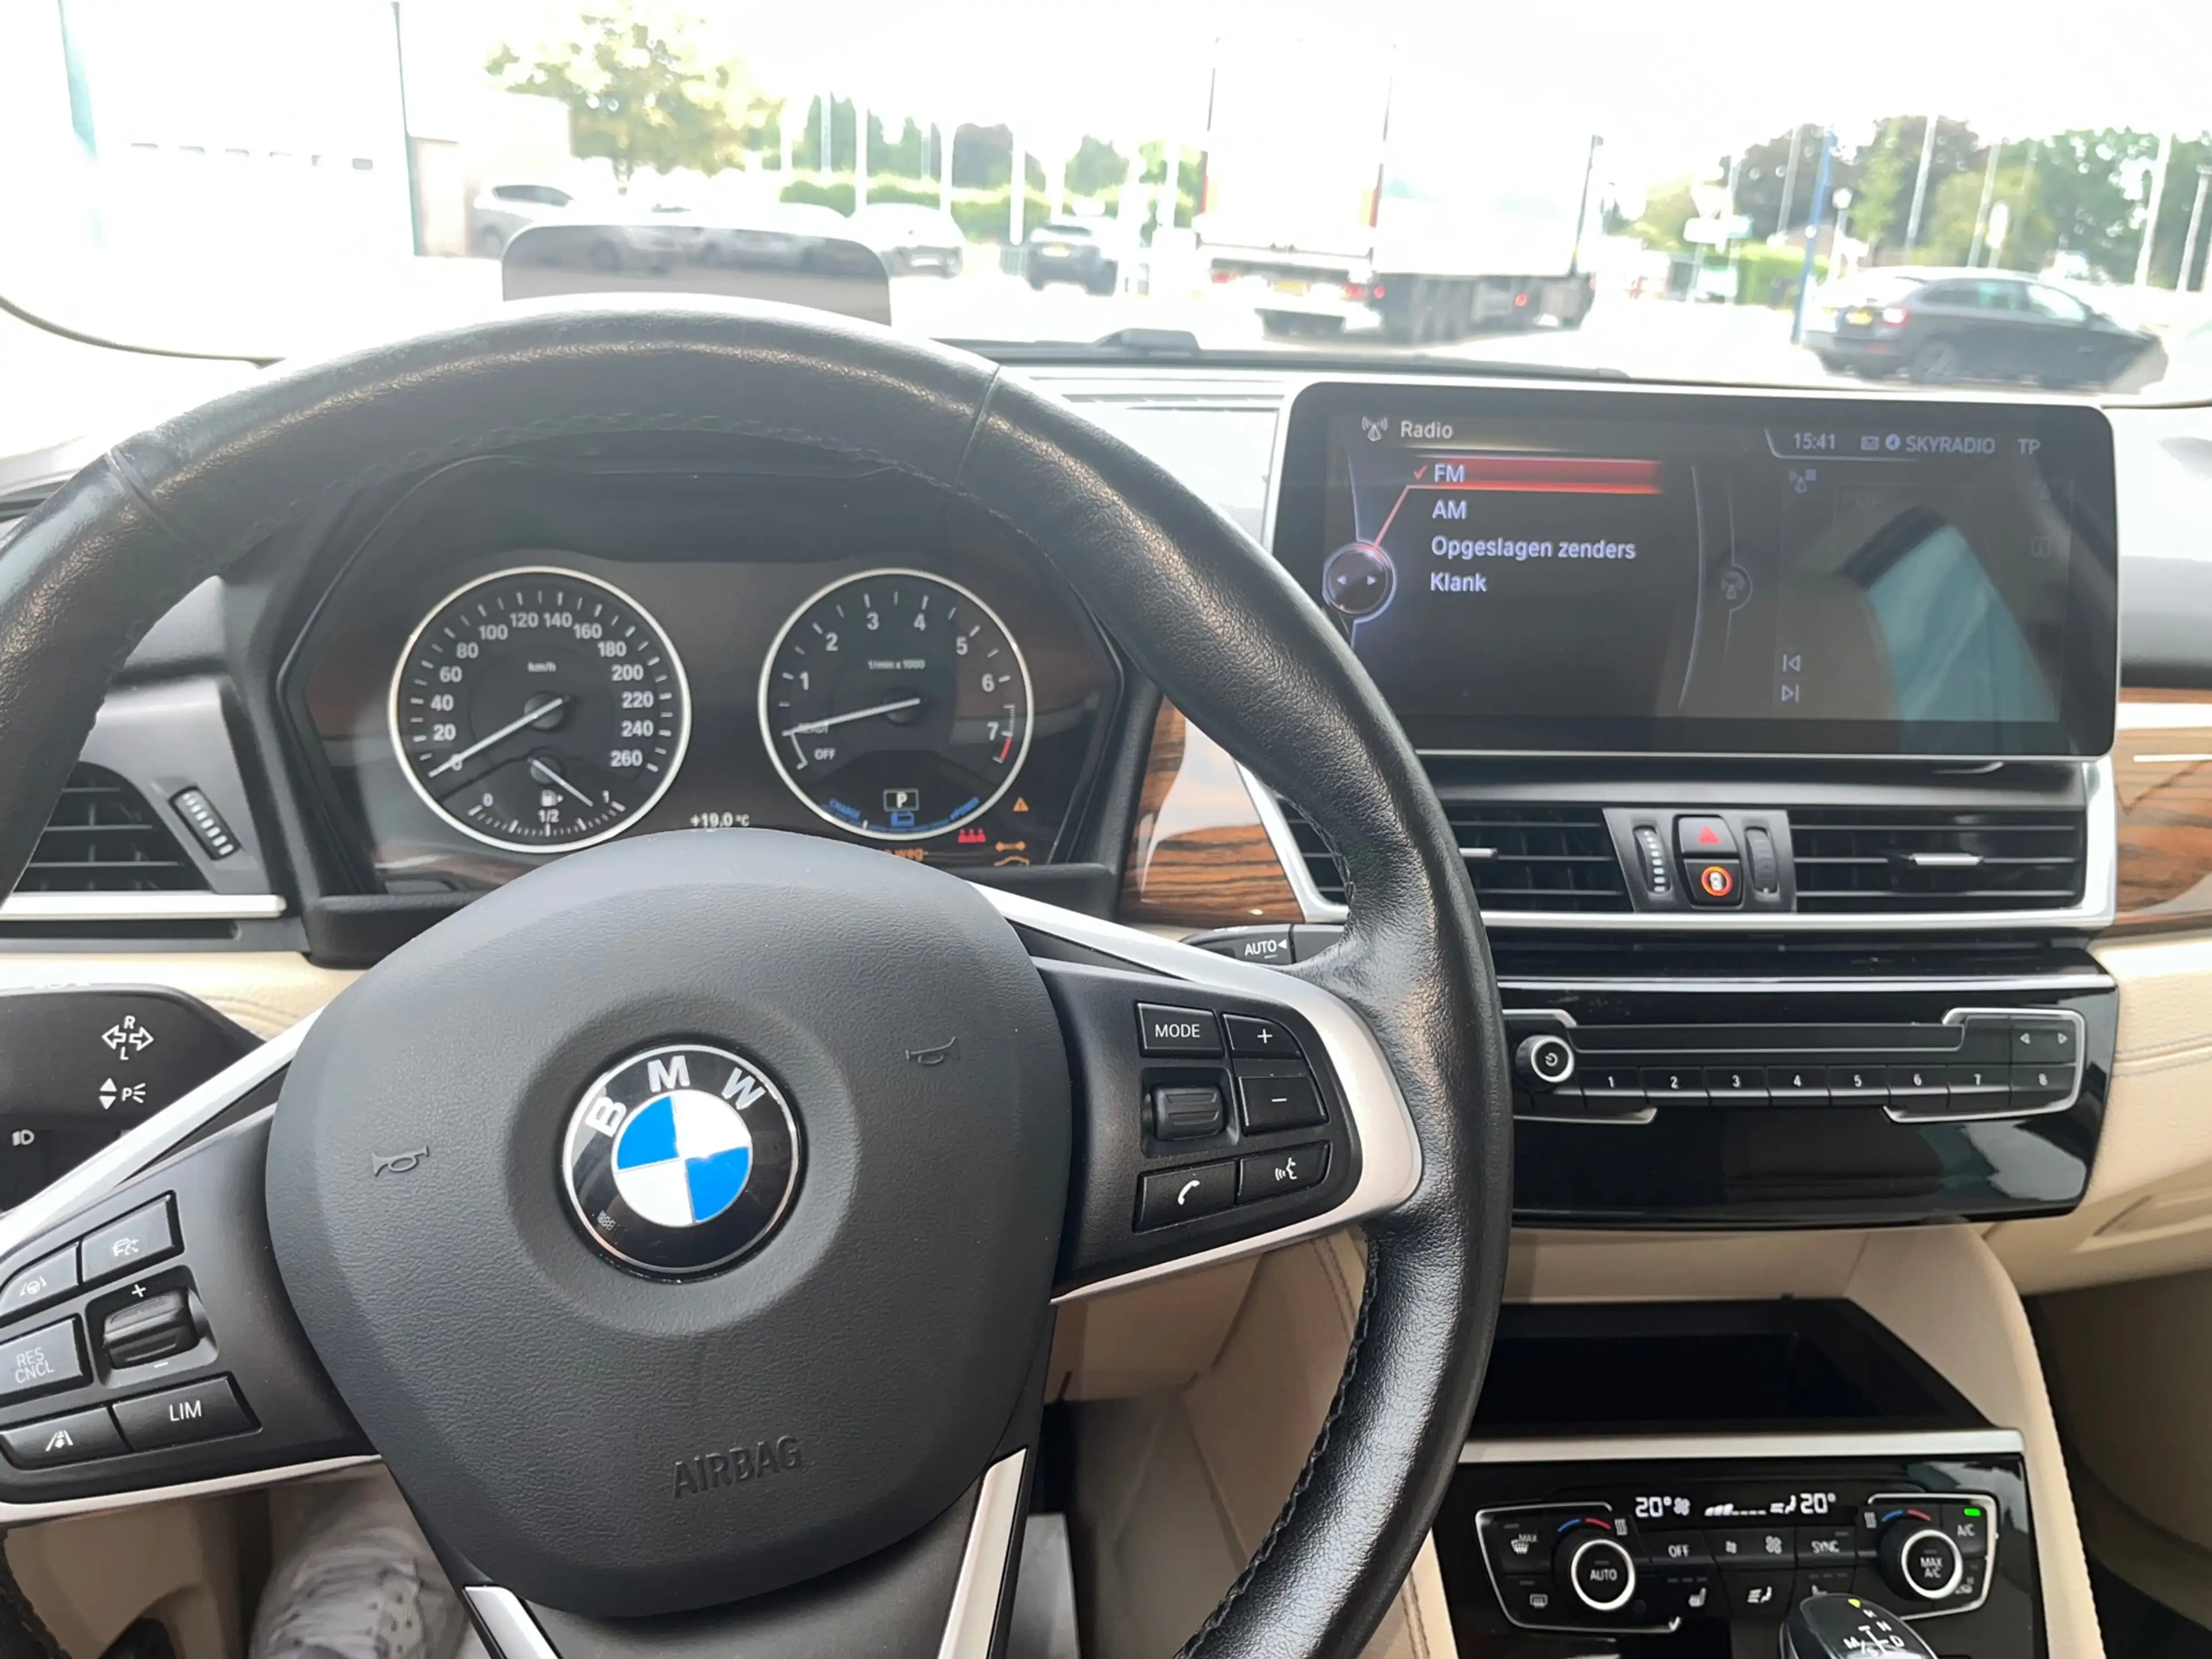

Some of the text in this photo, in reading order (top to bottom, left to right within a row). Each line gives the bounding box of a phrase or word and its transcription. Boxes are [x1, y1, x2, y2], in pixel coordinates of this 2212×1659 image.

[1400, 421, 1454, 440] Radio
[1793, 433, 1835, 450] 15:41
[1905, 435, 1995, 454] SKYRADIO
[2017, 438, 2041, 455] TP
[1434, 463, 1465, 483] FM
[1431, 499, 1468, 520] AM
[1431, 536, 1637, 562] Opgeslagen zenders
[1430, 571, 1488, 593] Klank
[510, 613, 539, 628] 120
[544, 612, 573, 628] 140
[866, 613, 879, 630] 3
[914, 612, 926, 630] 4
[479, 624, 509, 640] 100
[574, 623, 603, 639] 160
[597, 641, 627, 657] 180
[826, 633, 838, 652] 2
[956, 637, 968, 655] 5
[457, 643, 479, 659] 80
[440, 666, 462, 683] 60
[528, 661, 556, 673] km/h
[612, 665, 644, 681] 200
[800, 672, 809, 690] 1
[982, 674, 995, 692] 6
[431, 695, 454, 711] 40
[622, 692, 654, 709] 220
[433, 724, 456, 741] 20
[621, 721, 654, 737] 240
[987, 722, 998, 740] 7
[610, 751, 643, 767] 260
[813, 748, 836, 761] OFF
[483, 794, 494, 806] 0
[602, 791, 609, 804] 1
[896, 792, 908, 809] P
[539, 809, 559, 823] 1/2
[1244, 940, 1277, 956] AUTO
[123, 1015, 136, 1030] R
[1154, 1023, 1201, 1039] MODE
[119, 1046, 129, 1060] L
[1608, 1076, 1615, 1089] 1
[1670, 1076, 1679, 1089] 2
[1732, 1075, 1741, 1088] 3
[1793, 1074, 1802, 1088] 4
[1854, 1074, 1862, 1088] 5
[1913, 1073, 1922, 1086] 6
[1974, 1073, 1981, 1086] 7
[2038, 1073, 2048, 1086] 8
[122, 1086, 132, 1101] P
[585, 1055, 767, 1138] BMW
[16, 1348, 46, 1369] RES
[15, 1363, 54, 1384] CNCL
[169, 1400, 202, 1422] LIM
[672, 1434, 802, 1499] AIRBAG
[1519, 1533, 1538, 1544] MAX
[1957, 1524, 1975, 1537] A/C
[1668, 1544, 1690, 1558] OFF
[1811, 1540, 1840, 1554] SYNC
[1920, 1557, 1942, 1569] MAX
[1589, 1568, 1618, 1582] AUTO
[1924, 1567, 1941, 1578] A/C
[1889, 1634, 1905, 1647] D
